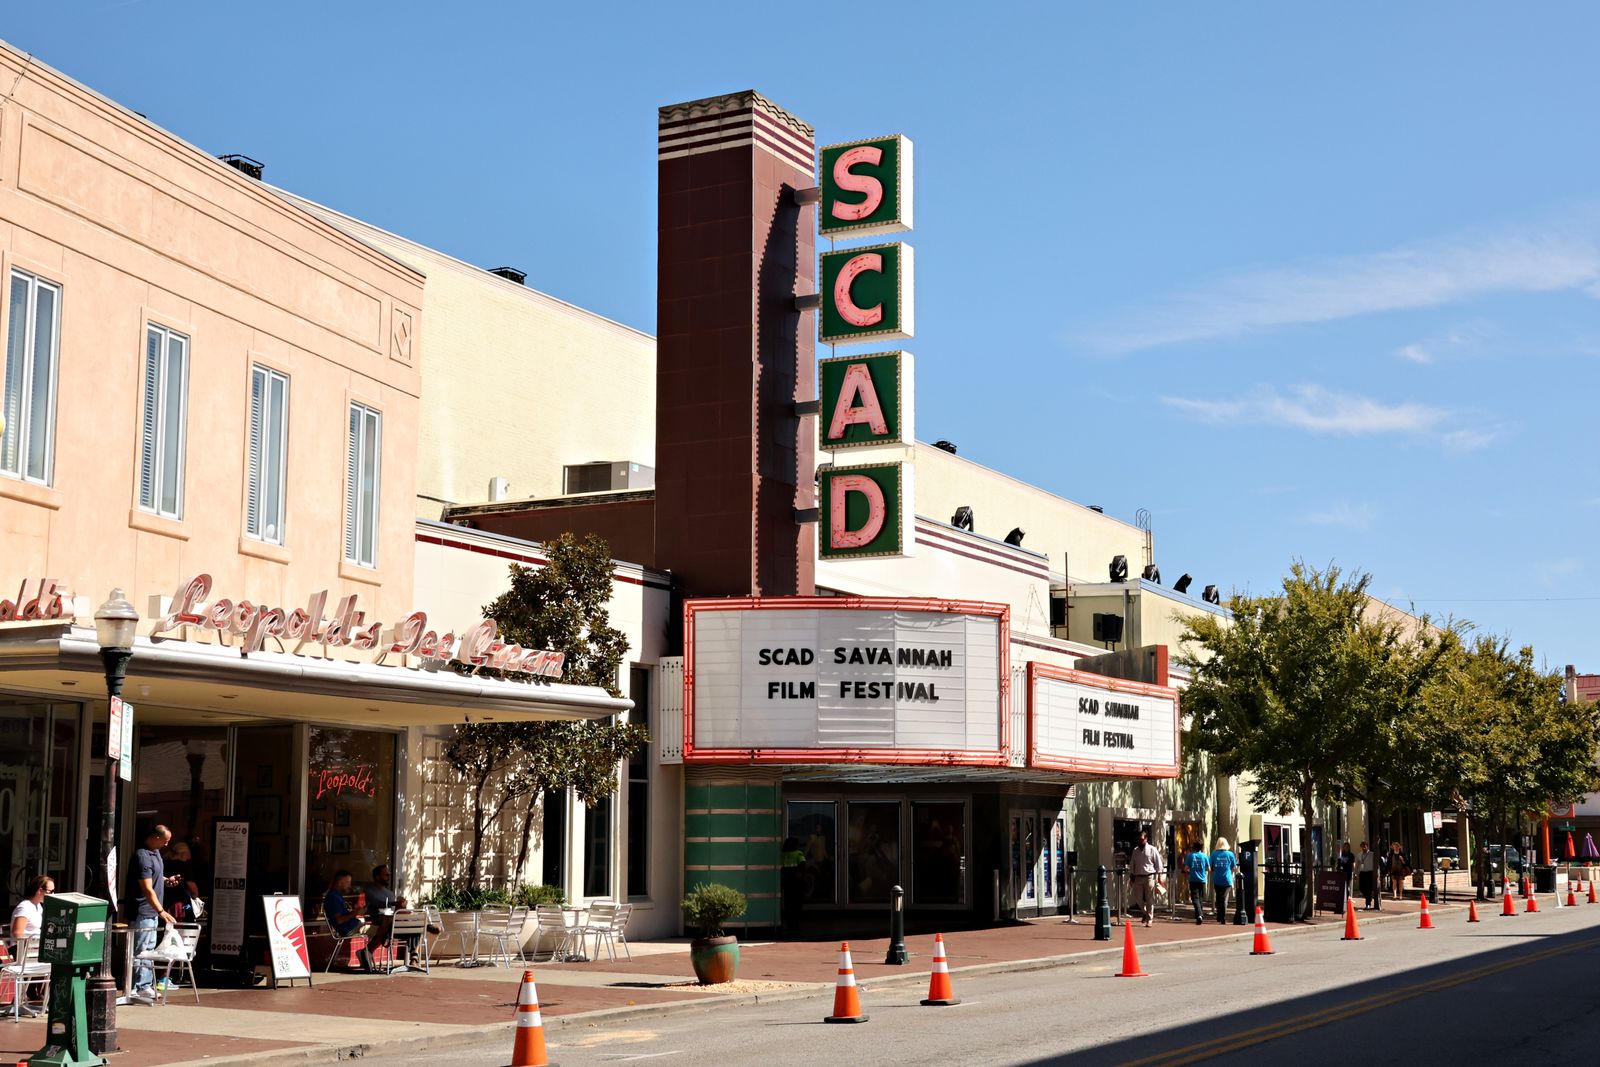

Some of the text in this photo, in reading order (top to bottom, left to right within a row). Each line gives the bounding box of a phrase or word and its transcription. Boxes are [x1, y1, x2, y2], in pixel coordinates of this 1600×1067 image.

[828, 145, 888, 549] SCAD
[150, 573, 566, 679] Leopold's Ice Cream
[758, 646, 953, 668] SCAD SAVANNAH
[768, 681, 940, 702] FILM FESTIVAL
[1078, 697, 1139, 720] SCAD SAVANNAH
[1083, 728, 1135, 750] FILM FESTIVAL
[316, 767, 376, 800] Leopold's
[1245, 851, 1251, 860] P
